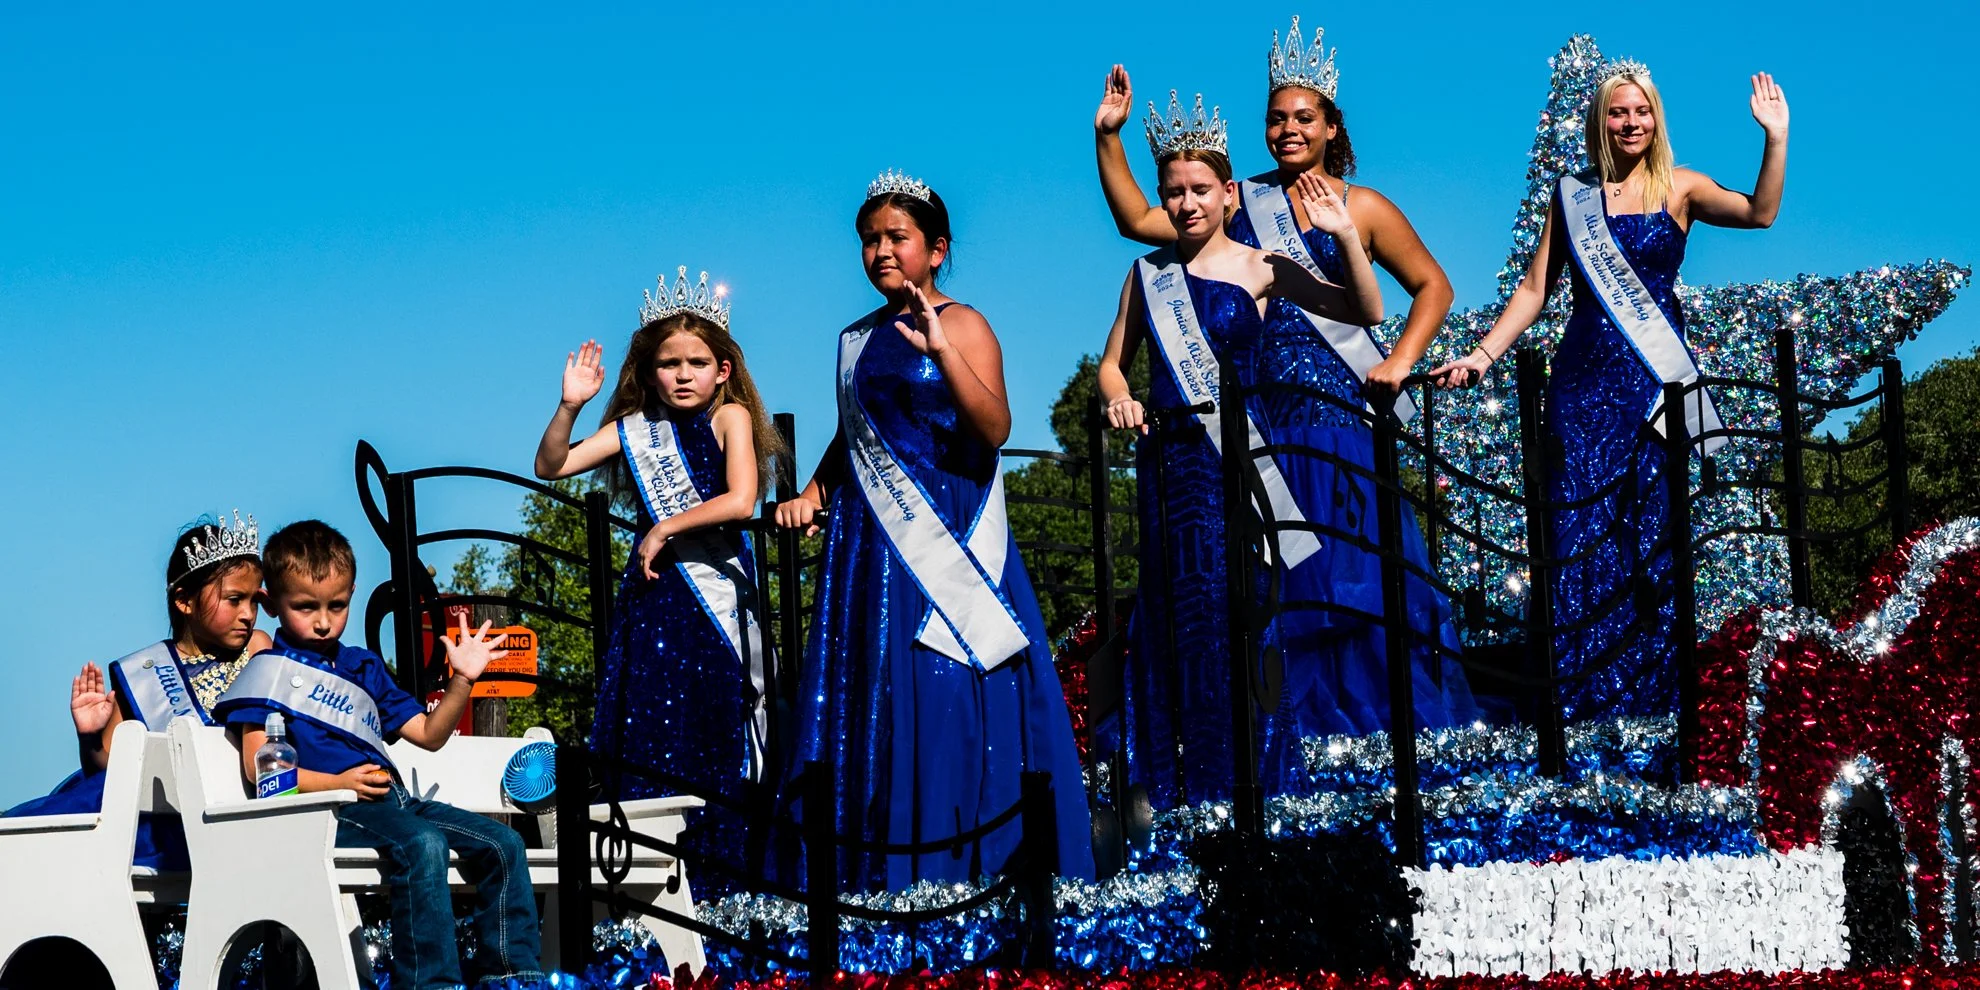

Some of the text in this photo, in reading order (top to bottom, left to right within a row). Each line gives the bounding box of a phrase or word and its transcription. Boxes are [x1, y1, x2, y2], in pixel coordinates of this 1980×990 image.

[1273, 211, 1287, 235] Miss
[1580, 238, 1624, 307] 1st Runner Up
[1584, 214, 1649, 321] Miss Schulenburg
[1167, 300, 1188, 336] Junior
[1185, 340, 1203, 368] Miss
[1180, 360, 1201, 397] Queen
[656, 453, 678, 488] Miss
[865, 445, 916, 522] Schulenburg
[154, 665, 184, 706] Little
[308, 683, 354, 715] Little
